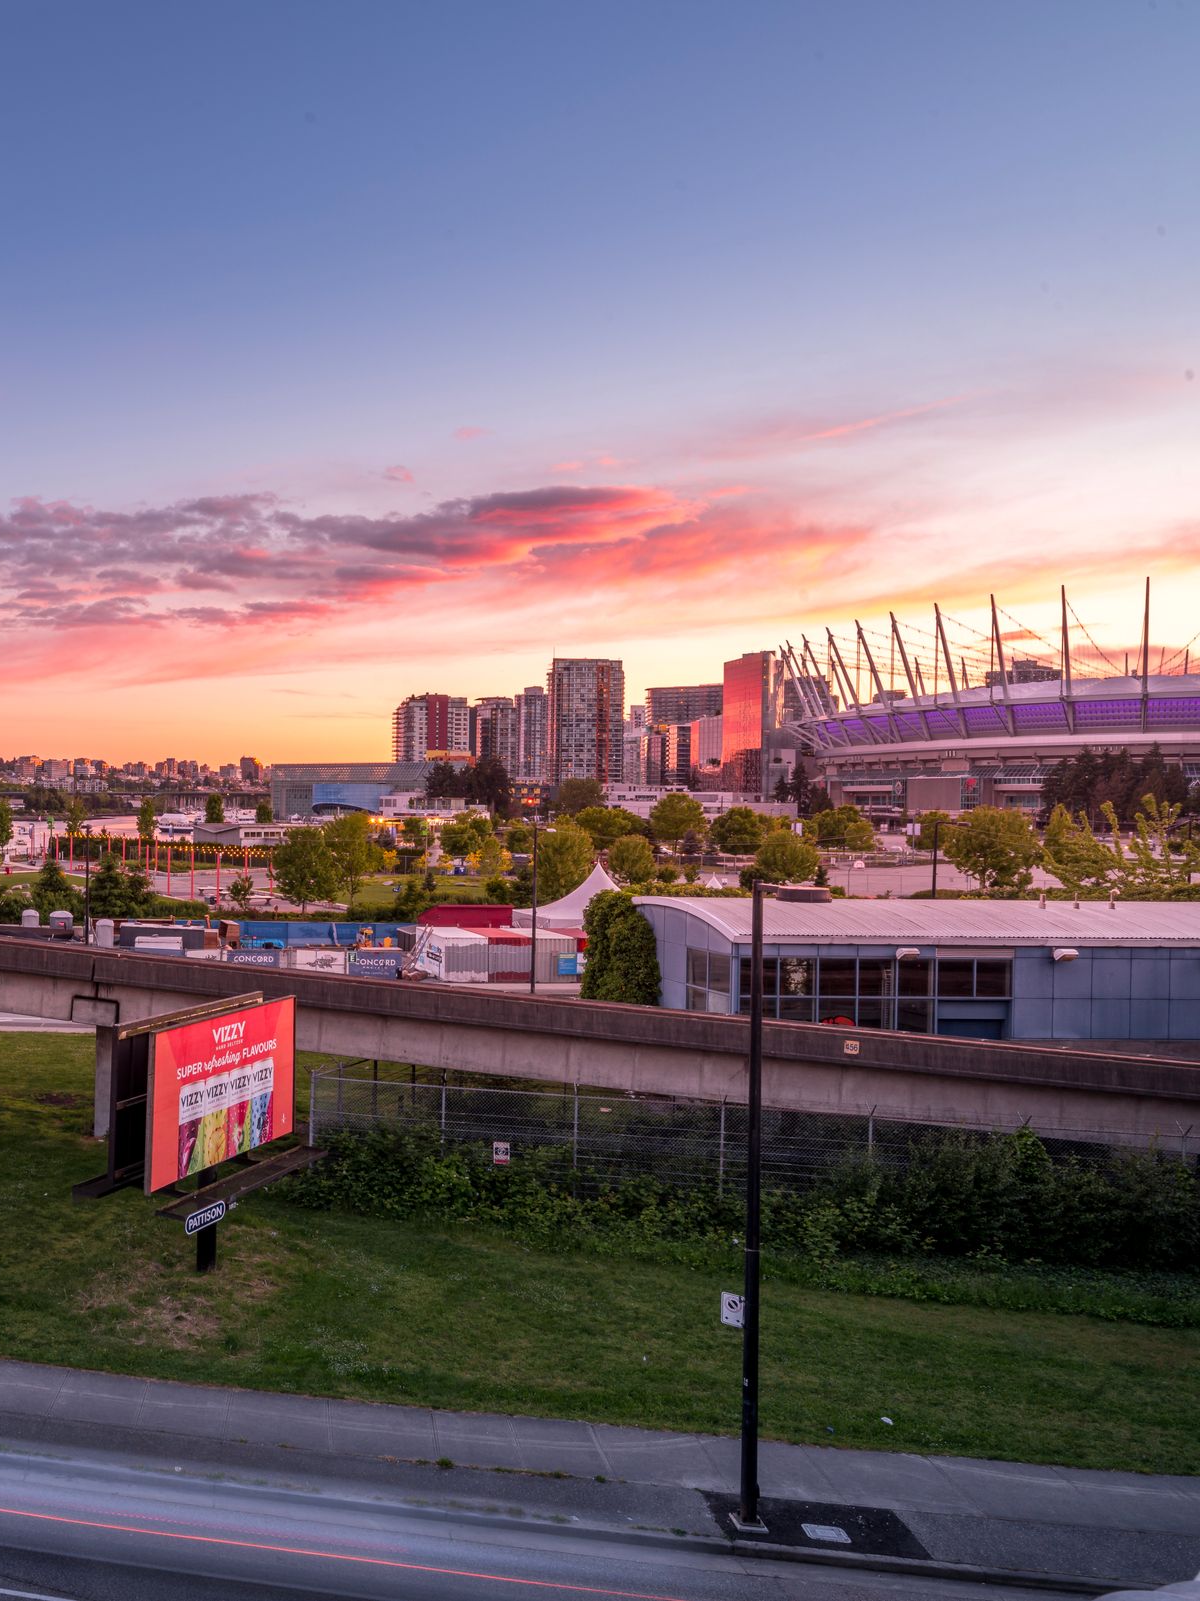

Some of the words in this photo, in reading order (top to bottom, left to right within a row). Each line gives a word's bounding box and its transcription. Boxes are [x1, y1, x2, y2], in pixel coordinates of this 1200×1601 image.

[233, 955, 274, 963] CONCORD
[212, 1021, 245, 1043] VIZZY
[176, 1062, 203, 1080] SUPER
[203, 1050, 241, 1073] refreshing
[242, 1039, 277, 1058] FLAVOURS
[230, 1074, 251, 1090] VIZZY
[252, 1067, 273, 1082] VIZZY
[181, 1090, 204, 1107] VIZZY
[206, 1081, 228, 1099] VIZZY
[188, 1205, 223, 1230] PATTISON
